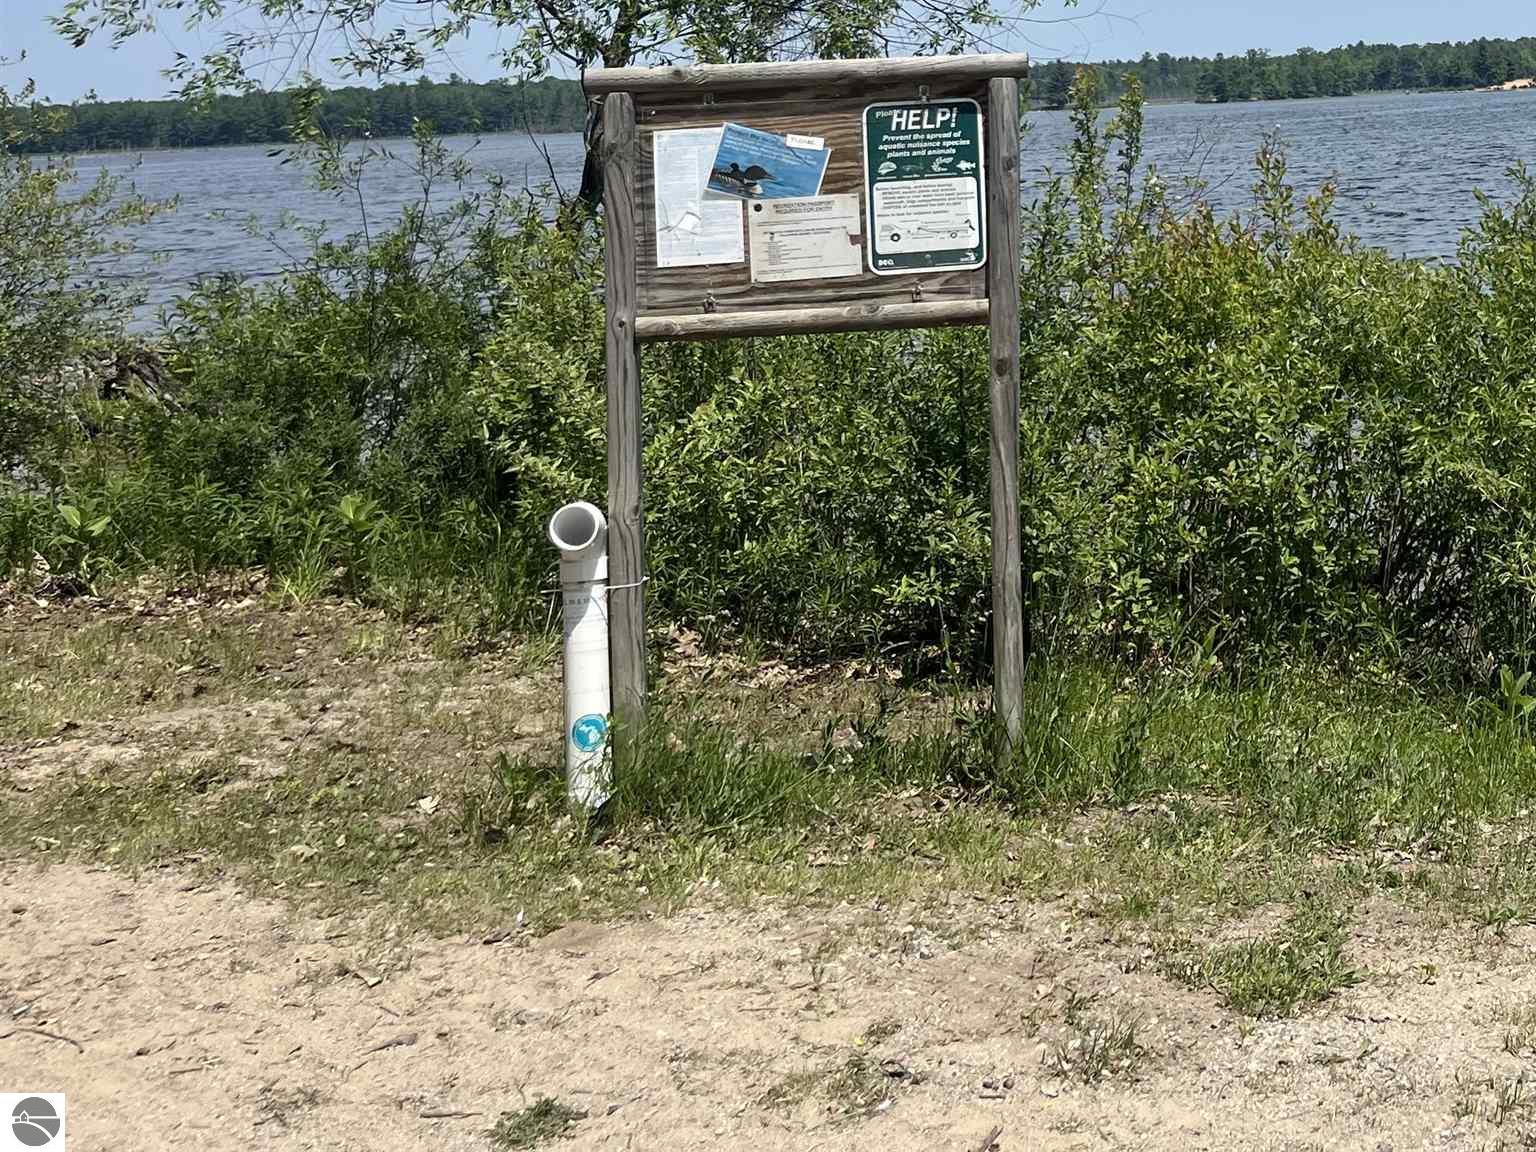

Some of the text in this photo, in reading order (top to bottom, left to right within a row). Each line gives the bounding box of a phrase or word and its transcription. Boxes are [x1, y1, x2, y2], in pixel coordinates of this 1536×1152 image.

[891, 107, 958, 131] HELP!
[882, 134, 911, 142] Prevent
[926, 131, 952, 140] spread
[878, 139, 970, 151] aquatic nuisance species
[887, 151, 910, 159] plants
